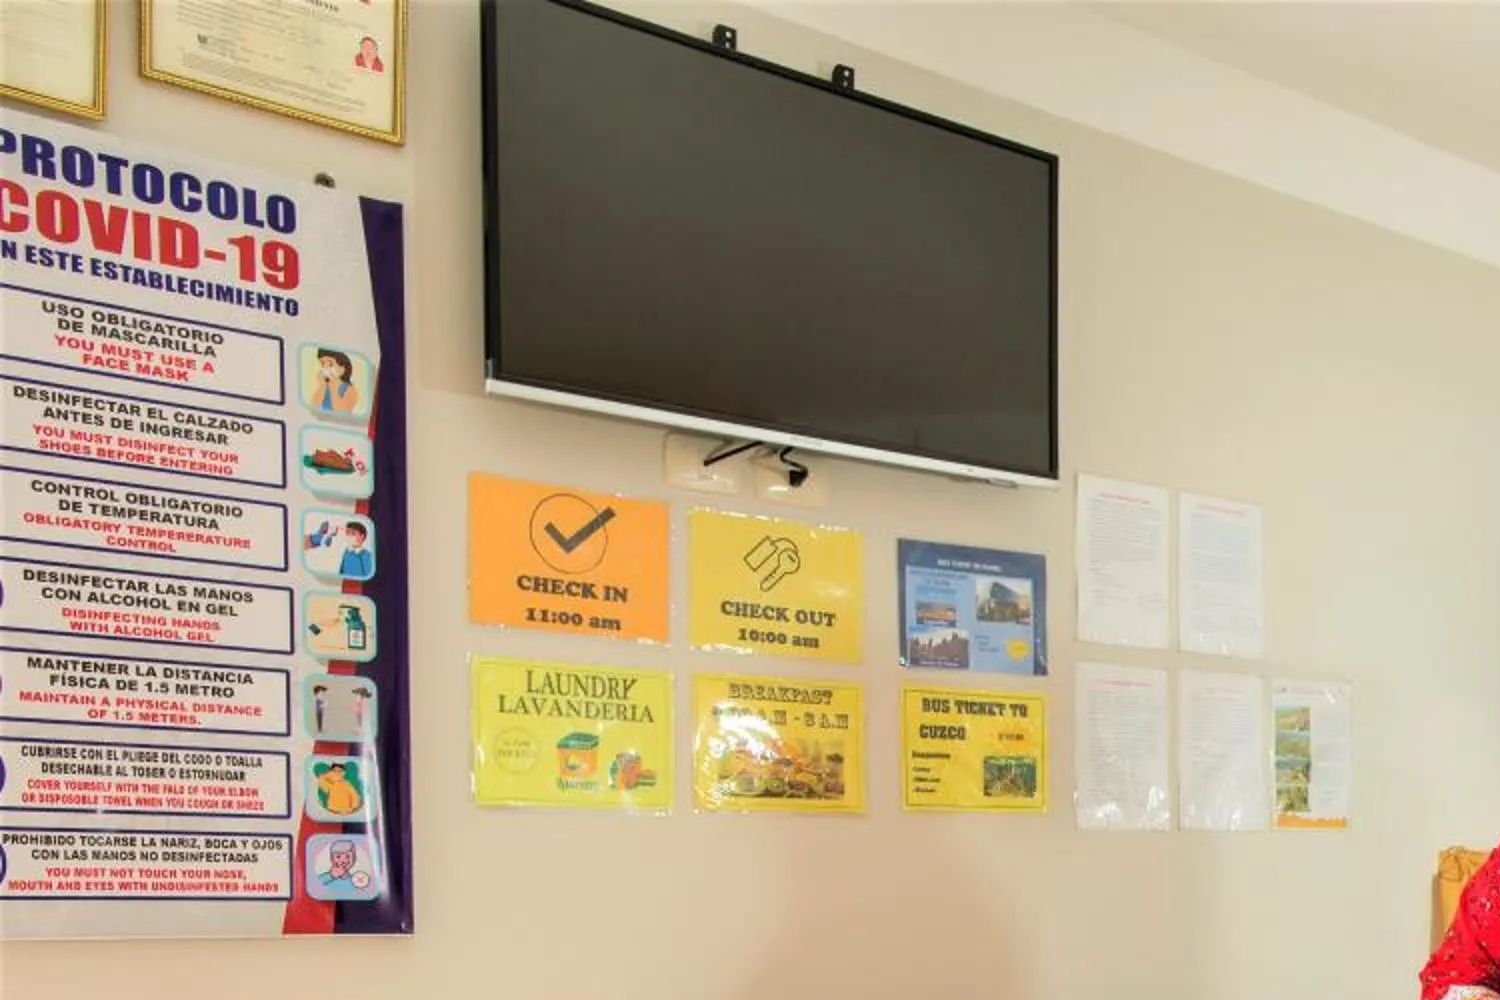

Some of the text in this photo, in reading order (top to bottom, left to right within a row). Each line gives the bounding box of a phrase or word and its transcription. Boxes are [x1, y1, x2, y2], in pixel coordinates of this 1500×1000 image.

[0, 178, 300, 291] COVID-19
[26, 245, 299, 317] ESTE ESTABLECIMIENTO
[41, 301, 225, 345] USO OBLIGATORIO
[57, 318, 217, 358] DE MASCARILLA
[54, 335, 214, 374] YOU MUST USE A
[82, 354, 190, 381] FACE MASK
[13, 385, 253, 434] DESINFECTAR EL CALZADO
[43, 407, 229, 446] ANTES DE INGRESAR
[32, 424, 239, 464] YOU MUST DISINFECT YOUR
[39, 439, 233, 475] SHOES BEFORE ENTERING
[31, 480, 243, 518] CONTROL OBLIGATORIO
[58, 499, 220, 530] DE TEMPERATURA
[23, 511, 251, 549] OBLIGATORY TEMPERERATURE
[106, 535, 176, 553] CONTROL
[23, 569, 253, 603] DESINFECTAR LAS MANOS
[516, 574, 628, 603] CHECK IN
[41, 587, 238, 617] CON ALCOHOL EN GEL
[720, 600, 837, 628] CHECK OUT
[61, 607, 221, 631] DISINFECTING HANDS
[69, 621, 215, 643] WITH ALCOHOL GEL
[525, 607, 622, 632] 11:00 am
[737, 627, 820, 649] 10:00 am
[27, 656, 254, 685] MANTENER LA DISTANCIA
[526, 669, 638, 700] LAUNDRY
[50, 674, 235, 698] FÍSICA DE 1.5 METRO
[727, 683, 833, 705] BREAKFAST
[19, 691, 264, 717] MAINTAIN A PHYSICAL DISTANCE
[87, 708, 107, 719] OF
[113, 710, 134, 721] 1.5
[498, 693, 655, 723] LAVANDERIA
[921, 697, 1028, 718] BUS TICKET TO
[919, 724, 967, 740] CUZCO
[21, 745, 77, 759] CUBRIRSE
[80, 748, 103, 760] CON
[106, 749, 118, 761] EL
[161, 752, 181, 764] DEL
[184, 753, 212, 766] CODO
[215, 755, 222, 766] O
[226, 755, 263, 768] TOALLA
[41, 761, 246, 781] DESECHABLE AL TOSER O ESTORNUDAR
[2, 833, 283, 851] PROHIBIDO TOCARSE LA NARIZ, BOCA Y OJOS
[31, 849, 259, 863] CON LAS MANOS NO DESINFECTADAS
[8, 880, 279, 893] MOUTH AND EYES WITH HANDS
[45, 867, 70, 877] YOU
[73, 867, 106, 877] MUST
[110, 868, 134, 878] NOT
[138, 868, 177, 878] TOUCH
[180, 868, 211, 879] YOUR
